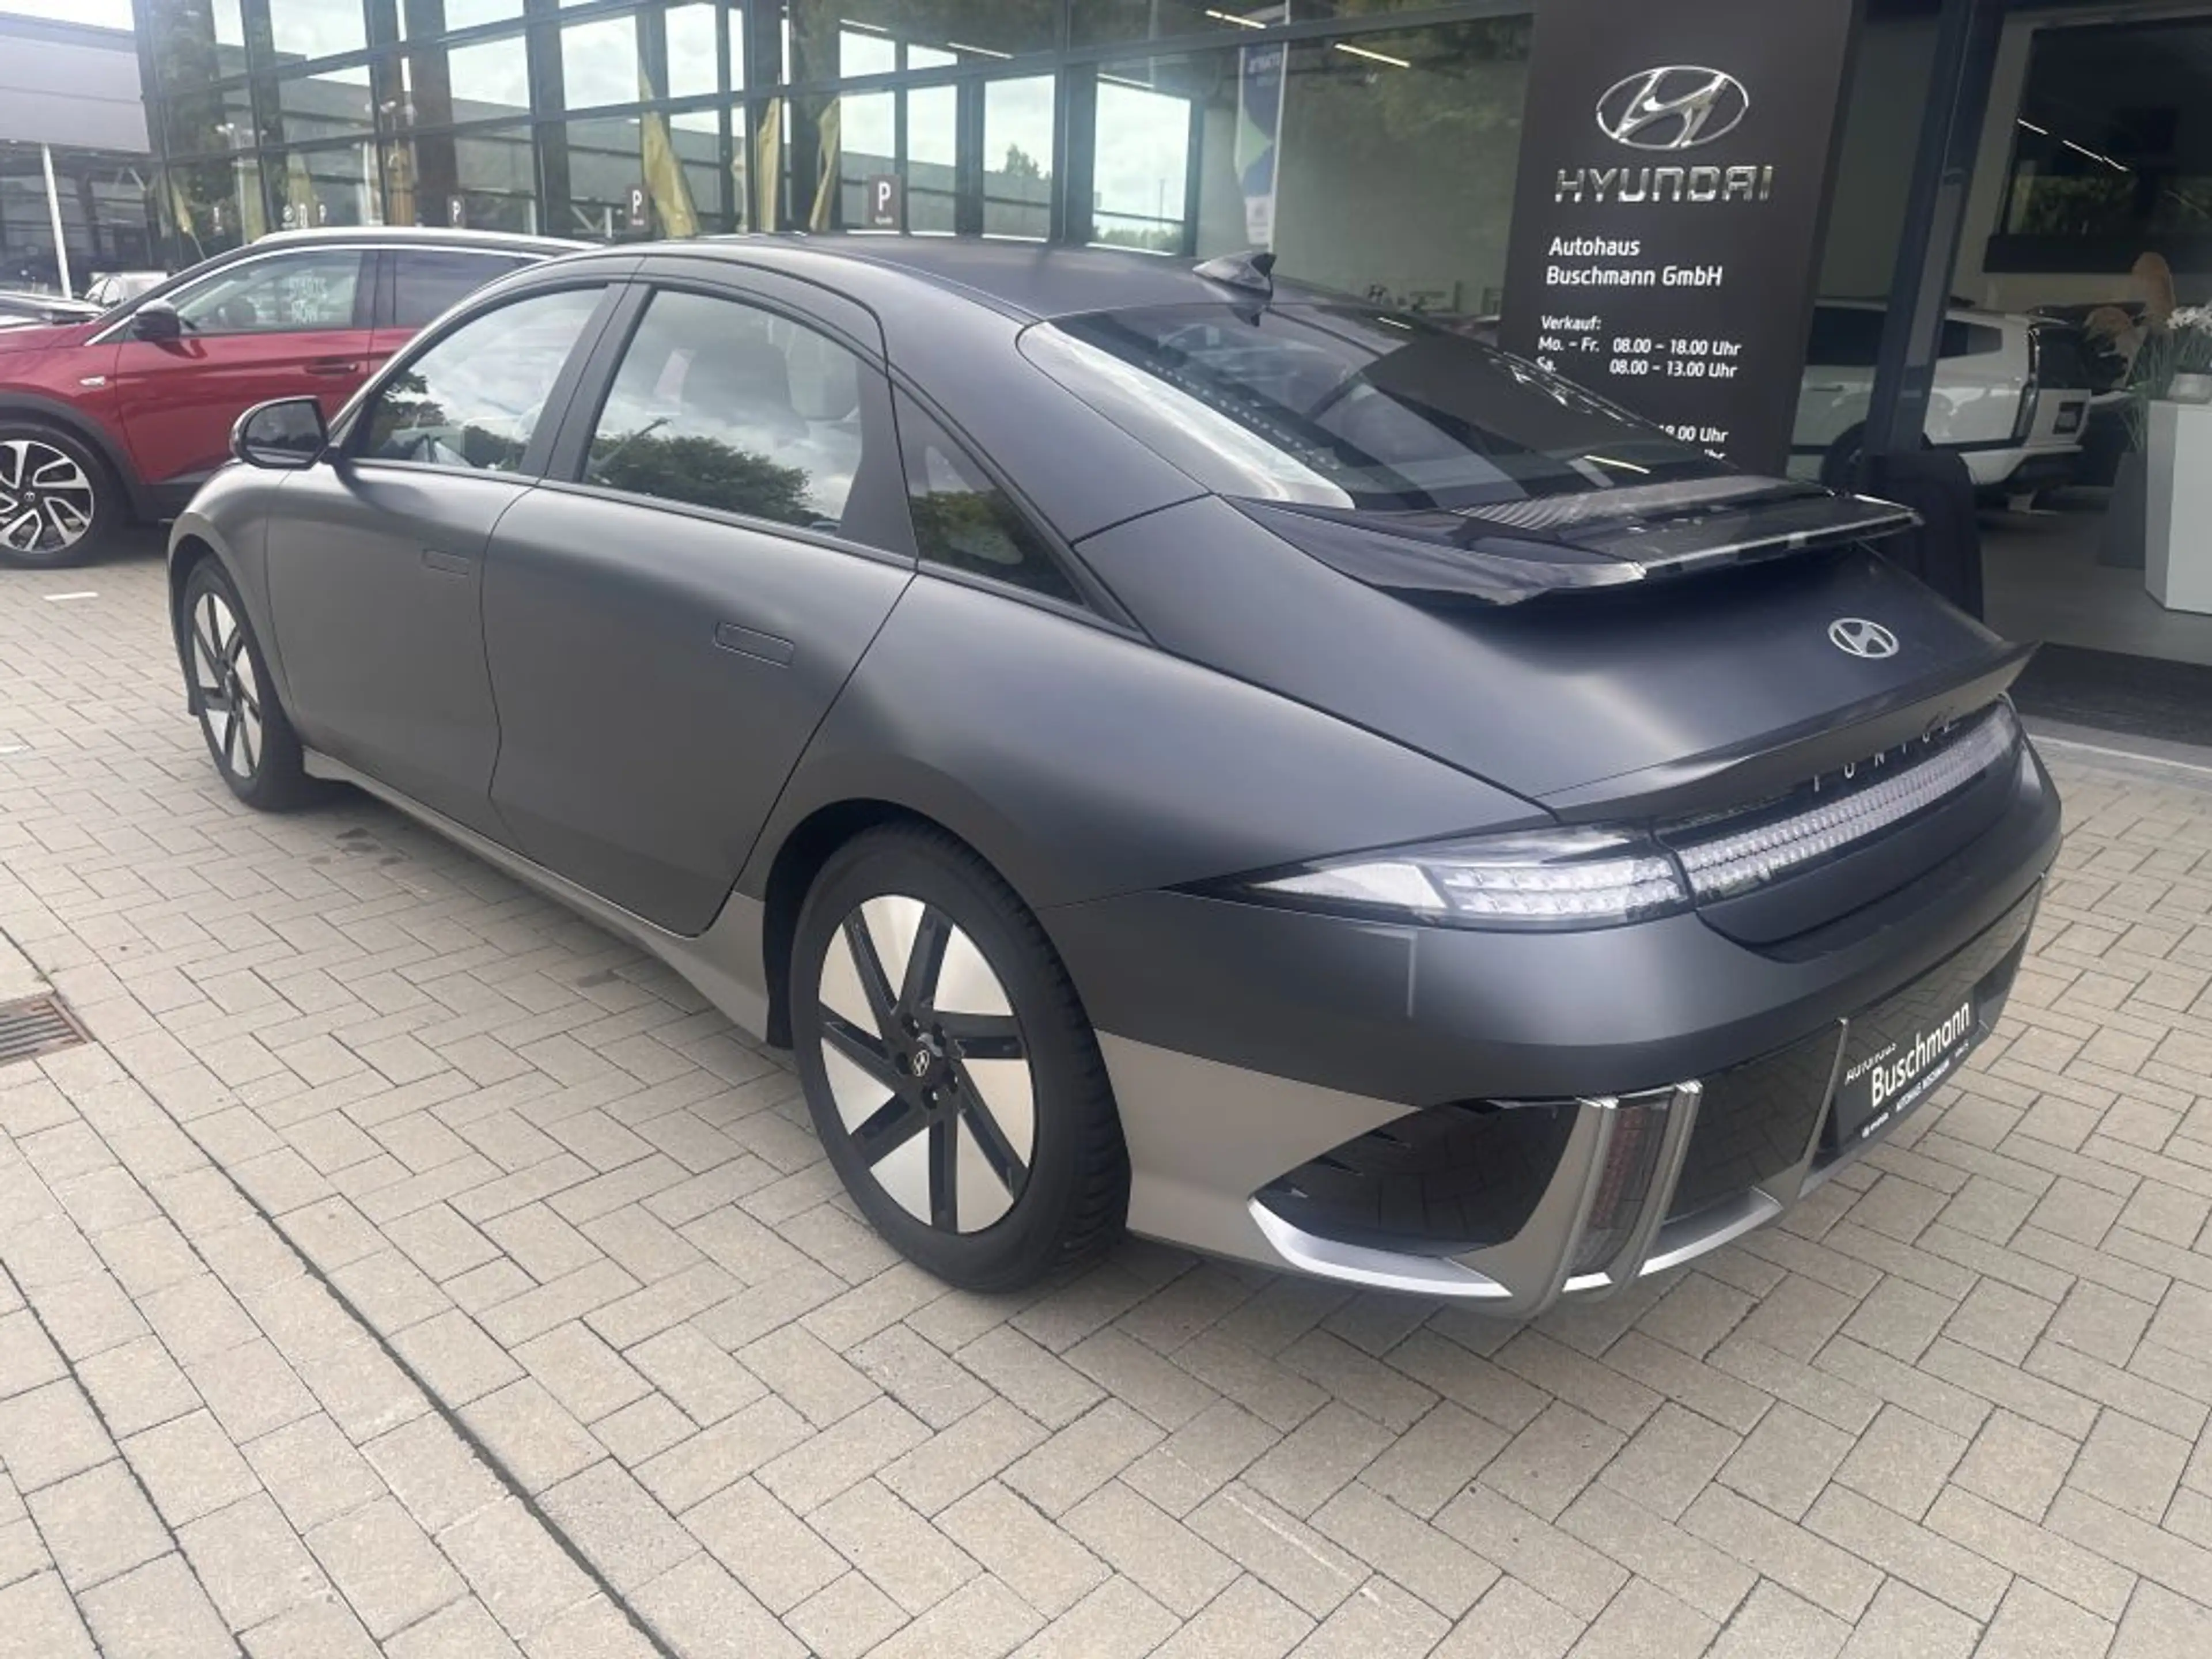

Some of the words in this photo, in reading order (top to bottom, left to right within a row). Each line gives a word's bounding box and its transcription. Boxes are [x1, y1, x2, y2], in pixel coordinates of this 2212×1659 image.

[1555, 165, 1773, 202] HYUNDAI
[632, 190, 642, 215] P
[878, 181, 891, 211] P
[1548, 236, 1641, 256] Autohaus
[1546, 265, 1656, 286] Buschmann
[1662, 265, 1723, 286] GmbH
[1540, 315, 1601, 331] Verkauf:
[1537, 336, 1565, 351] Mo.
[1581, 337, 1600, 352] Fr.
[1613, 337, 1652, 353] 08.00
[1671, 339, 1708, 355] 18.00
[1712, 340, 1742, 356] Uhr
[1609, 358, 1648, 374] 08.00
[1667, 361, 1705, 376] 13.00
[1709, 362, 1738, 378] Uhr
[1700, 427, 1729, 442] Uhr
[1872, 1002, 1970, 1108] Buschmann
